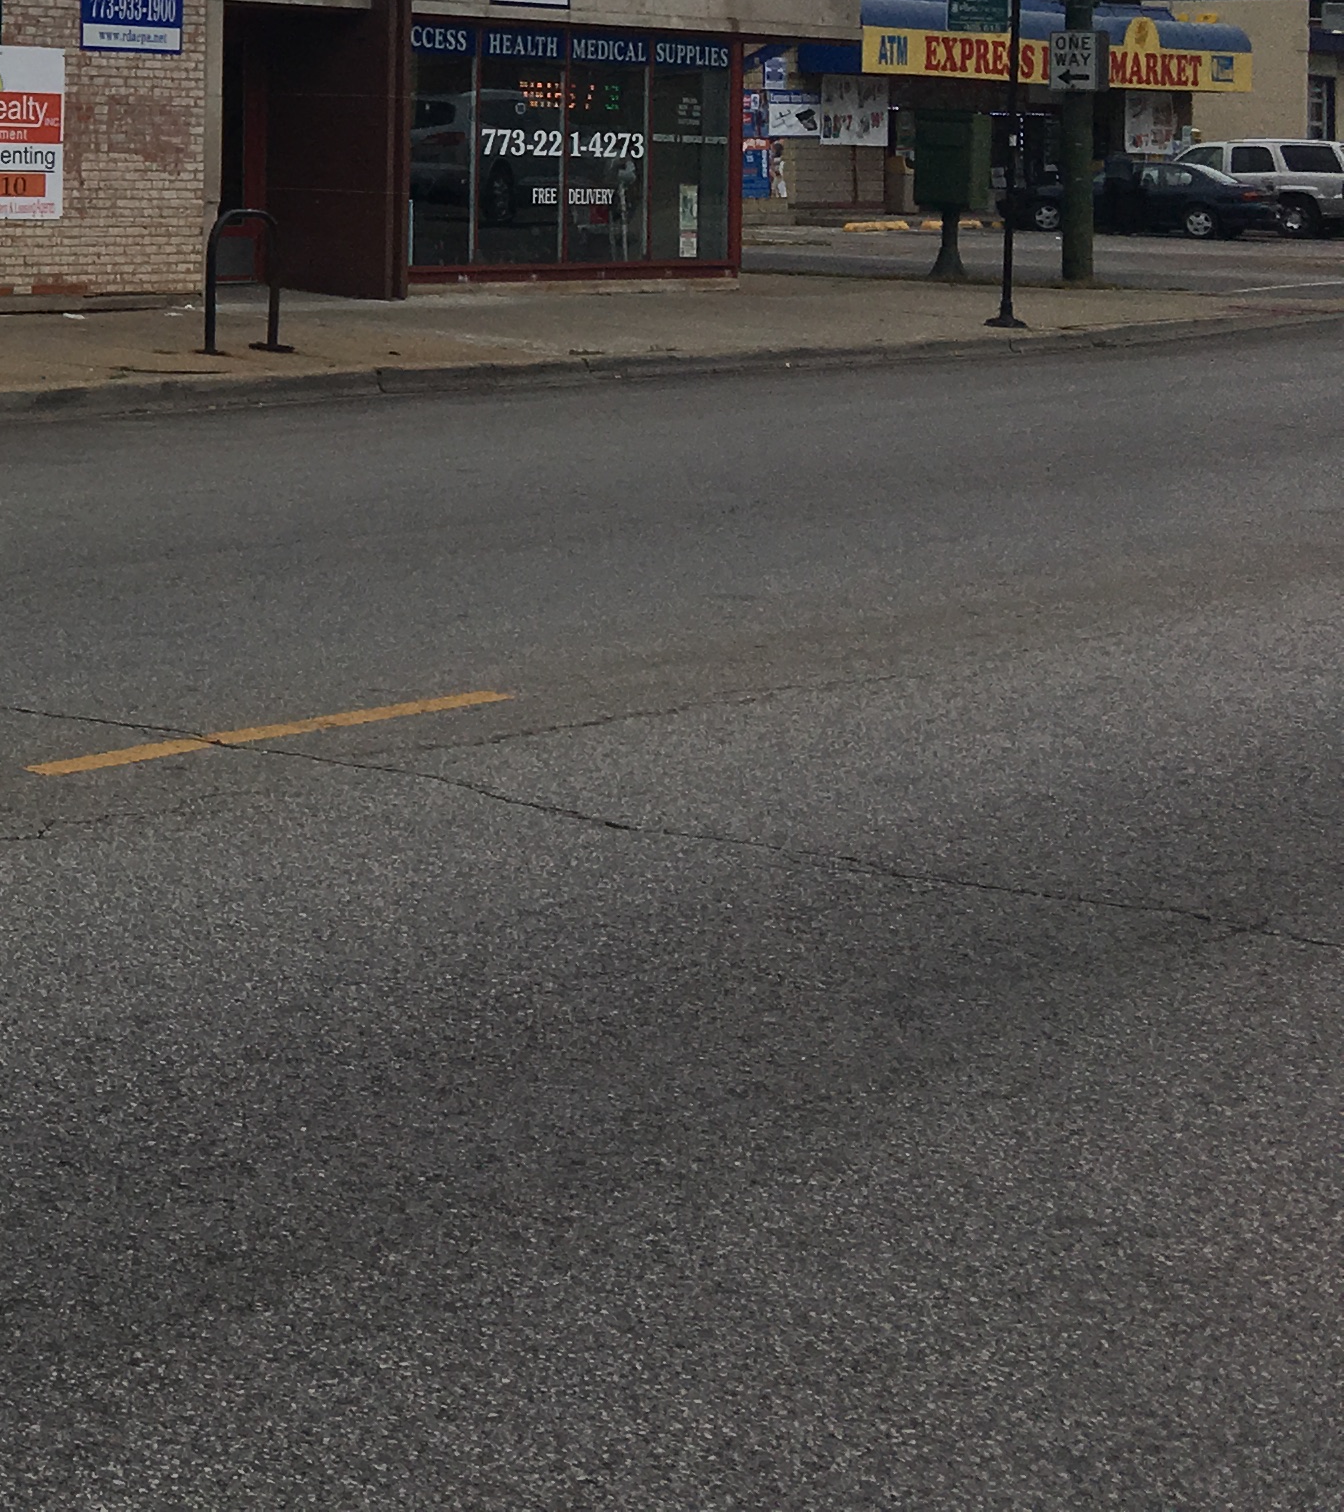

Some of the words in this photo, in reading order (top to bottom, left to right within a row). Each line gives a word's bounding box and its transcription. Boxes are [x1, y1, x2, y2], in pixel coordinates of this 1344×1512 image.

[410, 25, 467, 51] CCESS
[488, 33, 558, 58] HEALTH
[572, 38, 647, 62] MEDICAL
[655, 42, 729, 68] SUPPLIES
[1055, 36, 1091, 51] ONE
[878, 35, 908, 66] ATM
[1108, 51, 1202, 87] MARKET
[1053, 52, 1091, 67] WAY
[480, 128, 645, 159] 773-221-4273
[532, 187, 558, 206] FREE
[568, 188, 616, 206] DELIVERY
